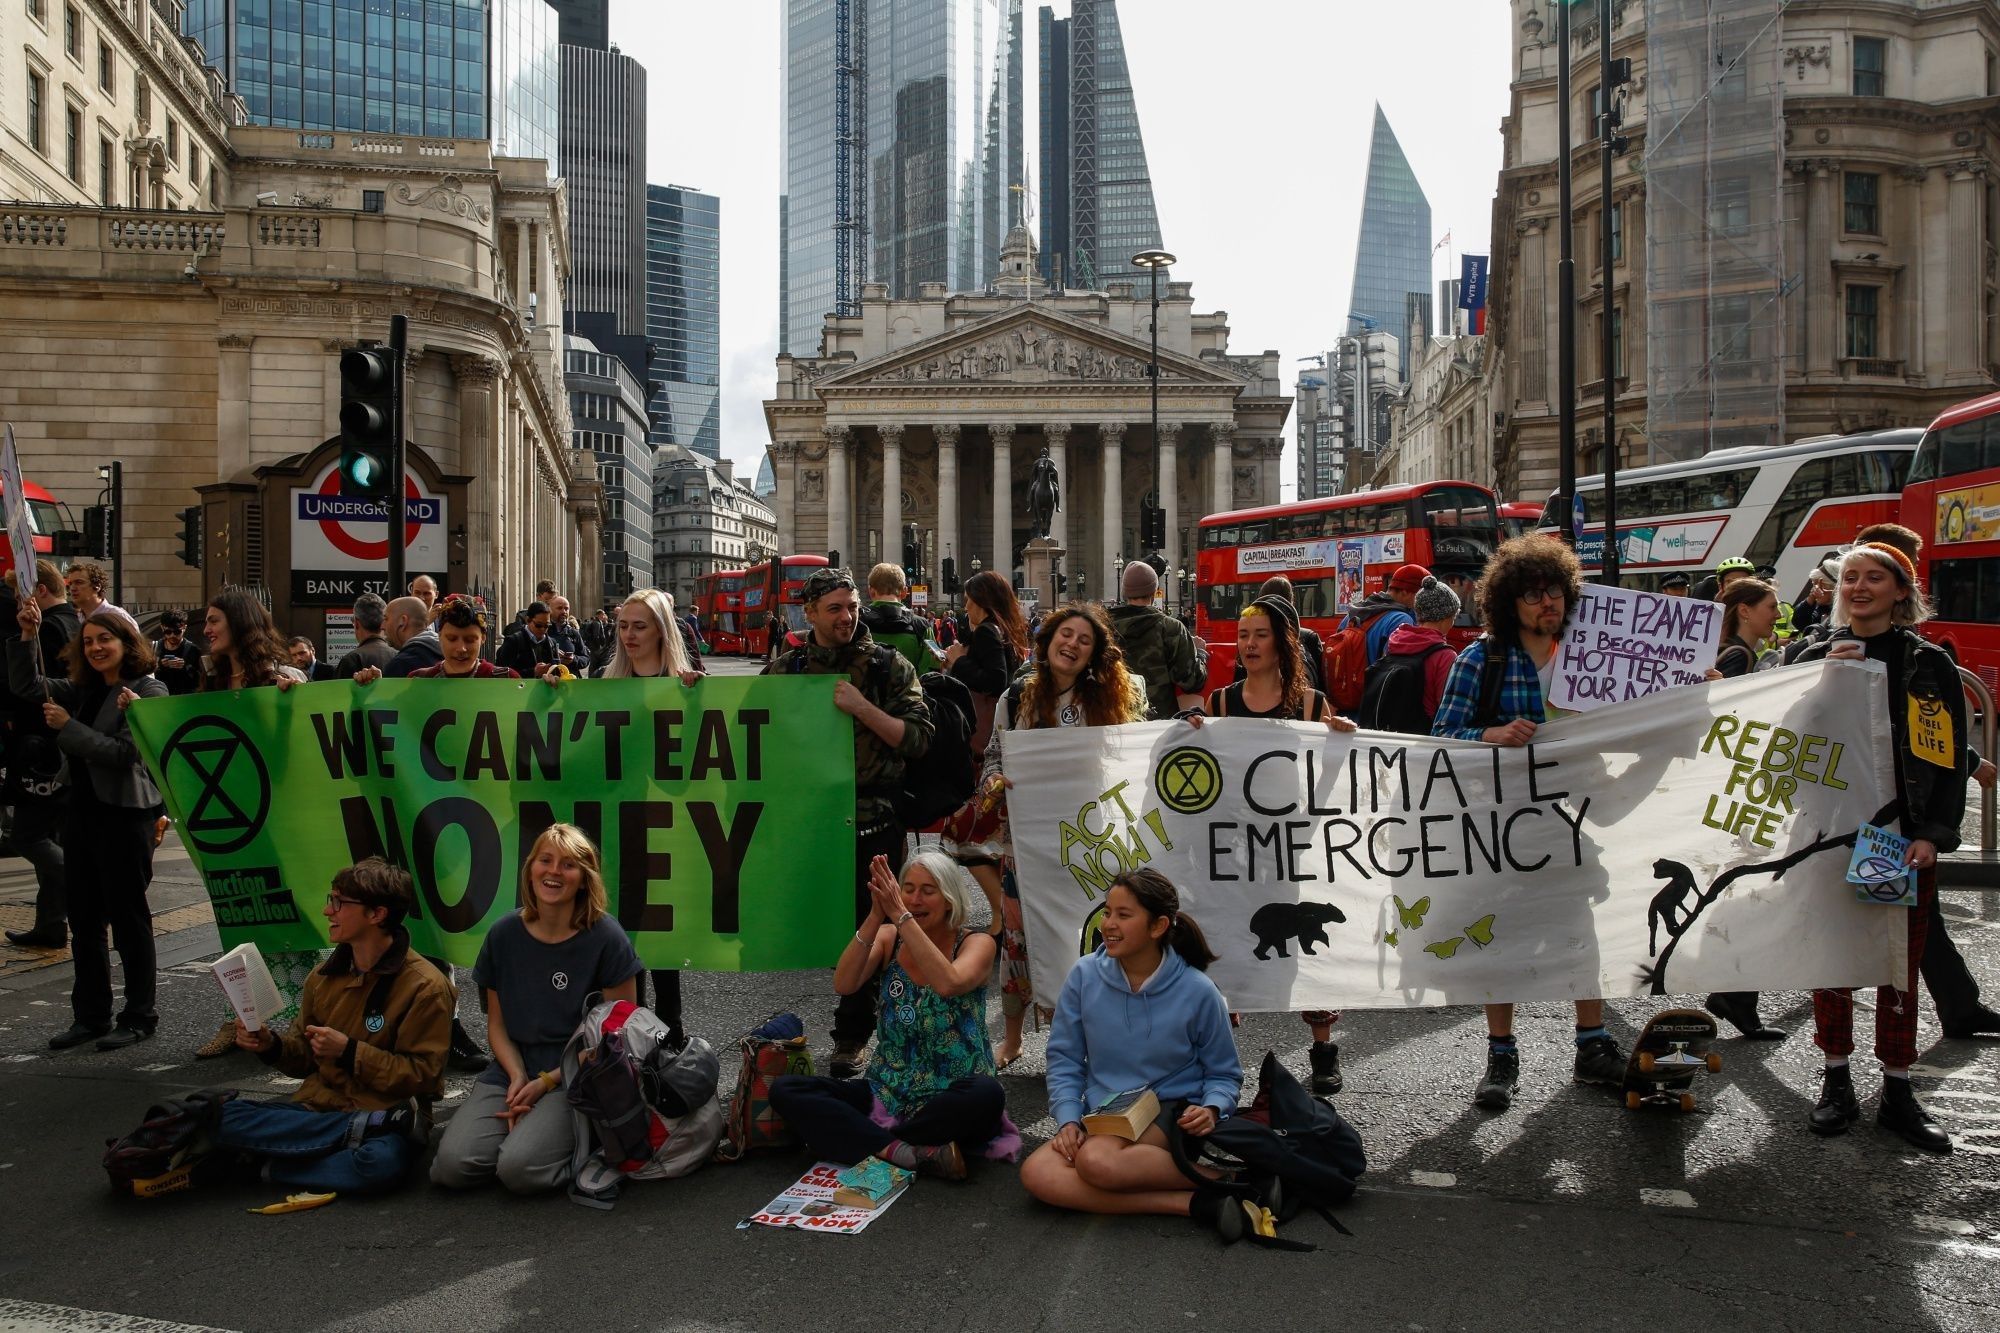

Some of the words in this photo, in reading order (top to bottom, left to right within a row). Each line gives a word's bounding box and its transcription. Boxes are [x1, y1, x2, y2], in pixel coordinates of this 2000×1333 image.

[1470, 262, 1479, 284] Capital
[1447, 544, 1465, 552] Paul's
[1575, 541, 1583, 550] HS
[1584, 539, 1620, 551] prescrips
[1666, 534, 1684, 548] well
[1684, 539, 1709, 547] Pharmacy
[1244, 550, 1268, 562] CAPITAL
[1270, 547, 1306, 560] BREAKFAST
[1295, 559, 1311, 567] ROMAN
[306, 580, 354, 594] BANK
[1577, 594, 1627, 628] THE
[1631, 593, 1715, 644] PLANET
[1571, 629, 1587, 644] IS
[1597, 631, 1696, 665] BECOMING
[1562, 644, 1669, 688] HOTTER
[1564, 674, 1617, 703] YOUR
[1918, 714, 1942, 730] REBEL
[310, 708, 399, 780] WE
[419, 708, 631, 783] CAN'T
[654, 708, 770, 782] EAT
[1700, 714, 1849, 791] REBEL
[1917, 732, 1945, 754] LIFE
[1243, 743, 1571, 817] CLIMATE
[1723, 762, 1798, 815] FOR
[1058, 778, 1138, 867] ACT
[1701, 793, 1785, 850] LIFE
[1208, 797, 1592, 884] EMERGENCY
[1861, 827, 1905, 852] IOLENT
[1870, 842, 1900, 862] NON
[207, 871, 267, 897] inction
[144, 1173, 189, 1193] CONSCIEN
[754, 1213, 803, 1225] ACT
[803, 1215, 862, 1229] NOW
